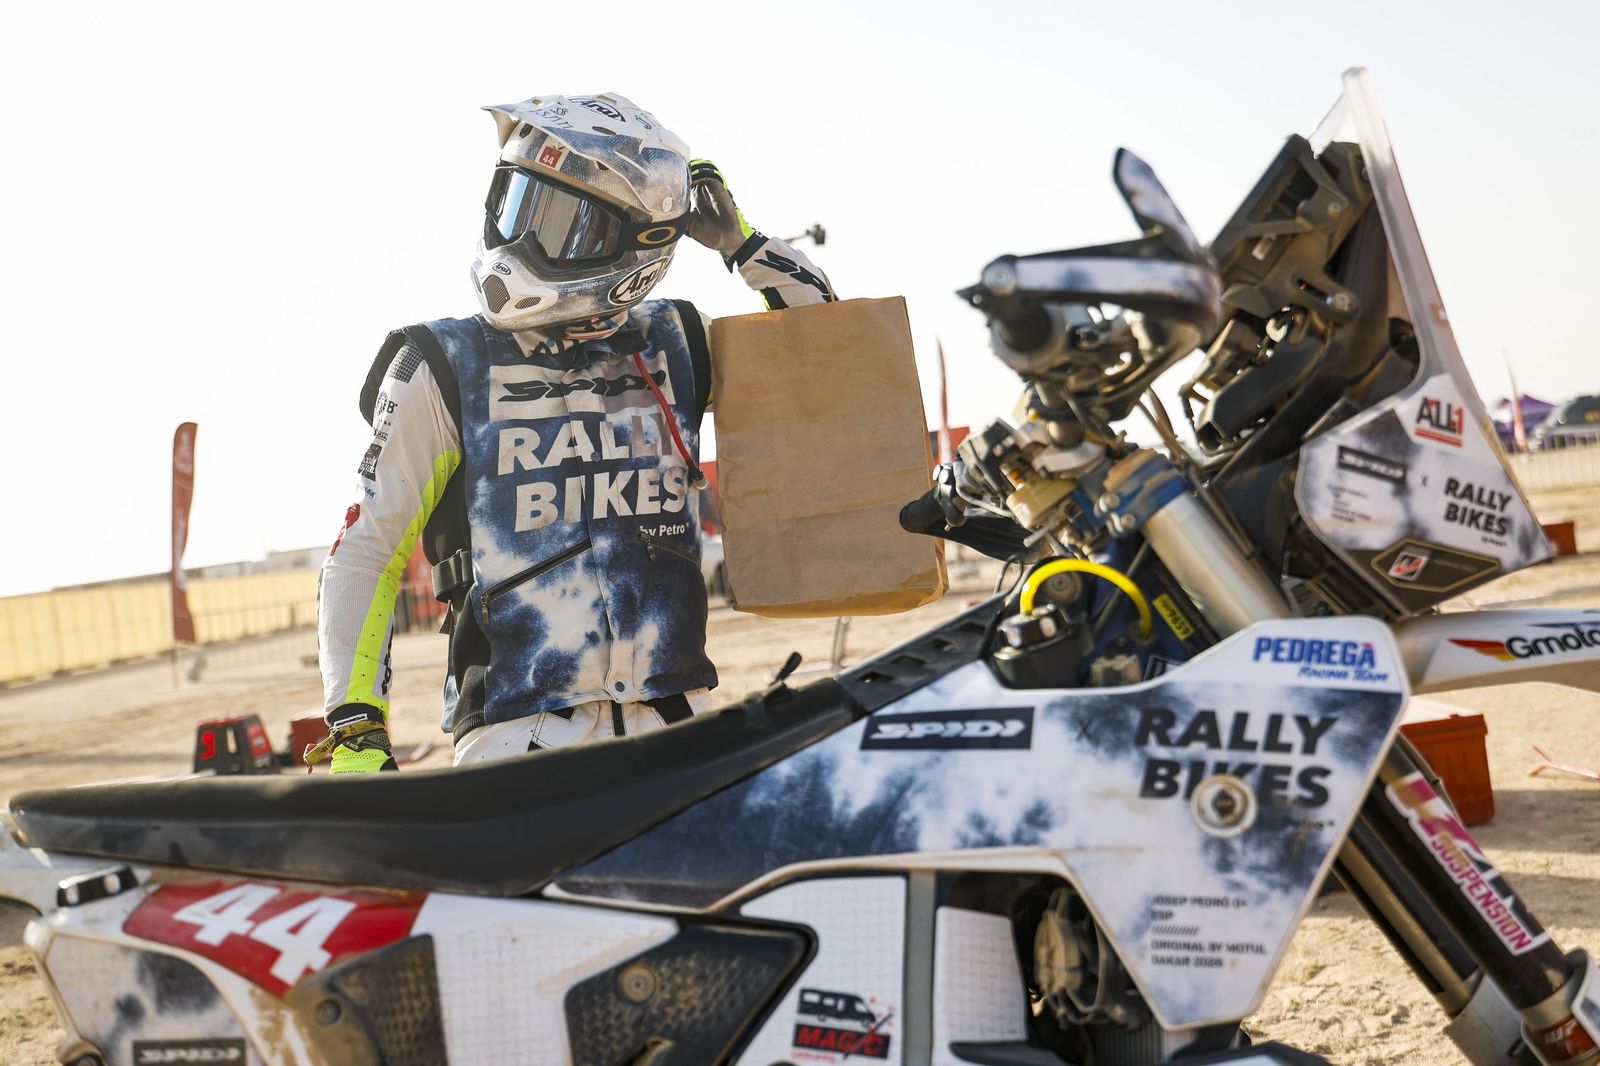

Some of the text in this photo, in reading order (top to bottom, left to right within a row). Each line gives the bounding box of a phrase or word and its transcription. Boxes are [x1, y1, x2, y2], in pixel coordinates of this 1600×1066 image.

[542, 154, 555, 165] 44
[498, 412, 679, 476] RALLY
[515, 465, 687, 533] BIKES
[1444, 477, 1512, 514] RALLY
[1444, 503, 1510, 537] BIKES
[870, 719, 1026, 739] SPIDI
[1135, 708, 1338, 755] RALLY
[1190, 896, 1228, 907] PEDRO
[172, 883, 357, 986] 44
[1208, 943, 1222, 953] BY
[1225, 944, 1266, 955] MOTUL
